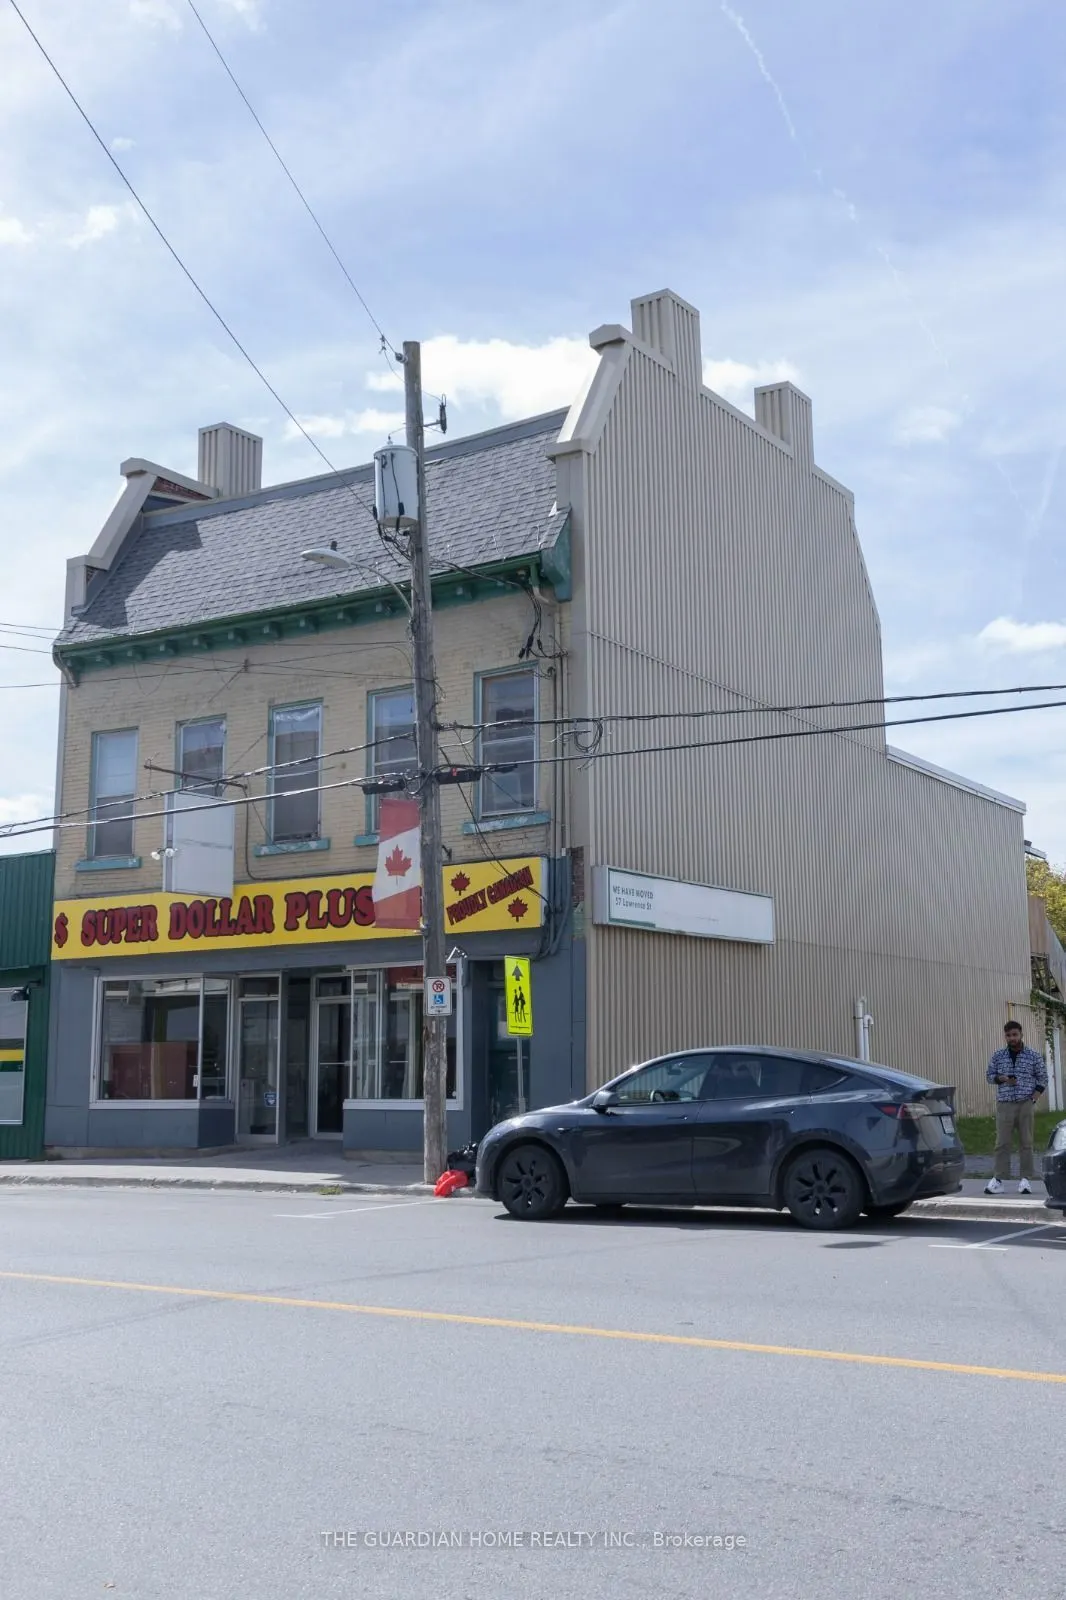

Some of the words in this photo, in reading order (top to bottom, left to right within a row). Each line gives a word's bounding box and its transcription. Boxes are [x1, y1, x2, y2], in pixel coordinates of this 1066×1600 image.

[54, 912, 69, 948] $
[81, 905, 159, 947] SUPER
[168, 895, 275, 940] DOLLAR
[284, 885, 377, 931] PLUS
[446, 888, 488, 926] PROUDLY
[487, 865, 534, 905] CANADIAN
[621, 887, 635, 897] HAVE
[635, 889, 654, 900] MOVED
